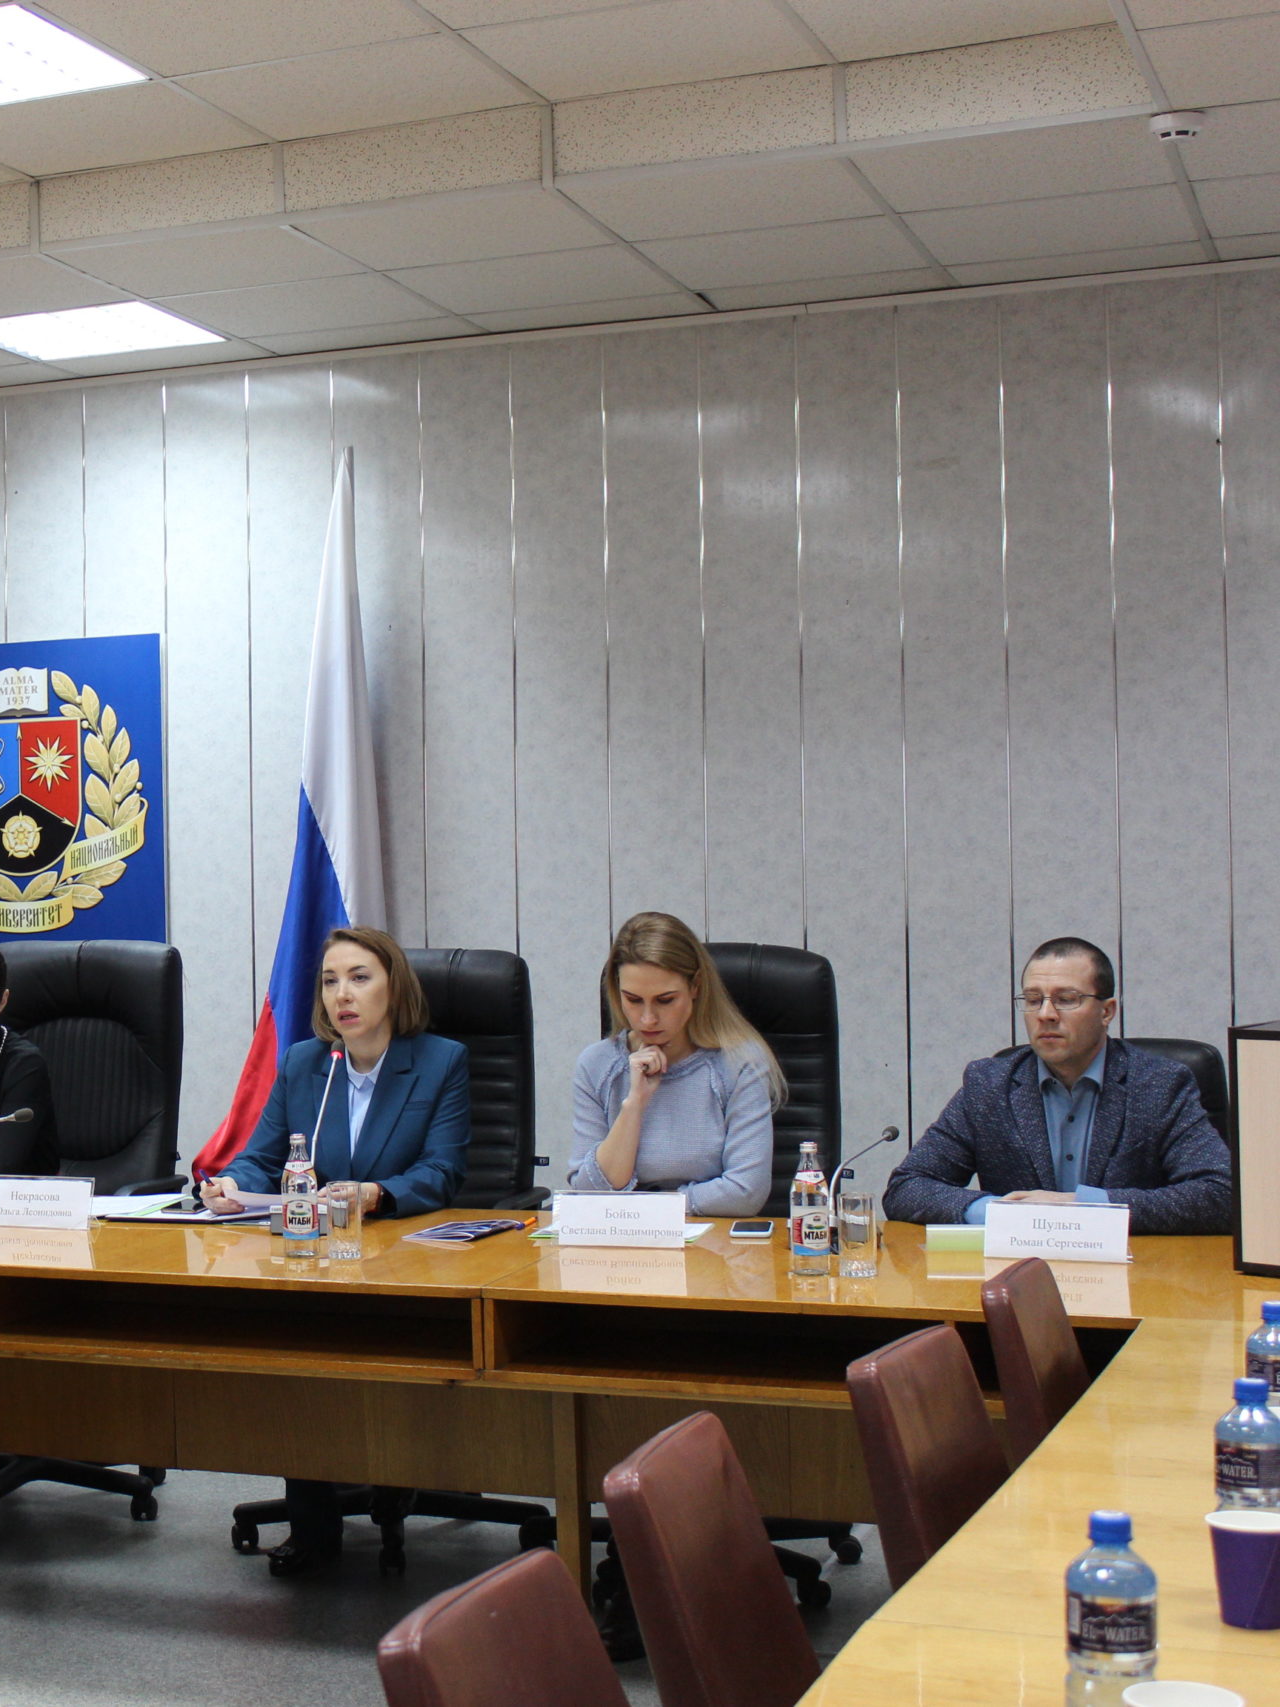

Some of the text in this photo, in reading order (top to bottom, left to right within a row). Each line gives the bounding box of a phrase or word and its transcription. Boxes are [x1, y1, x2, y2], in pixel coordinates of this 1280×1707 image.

[2, 675, 34, 685] ALMA
[0, 686, 38, 696] MATER
[7, 696, 30, 705] 1937
[10, 1191, 60, 1203] Некрасова
[22, 1207, 72, 1217] Леонидовна
[605, 1208, 640, 1220] Бойко
[1032, 1218, 1081, 1232] Шульга
[561, 1225, 683, 1238] Светлана Владимировна
[1010, 1236, 1103, 1250] Роман Сергеевич
